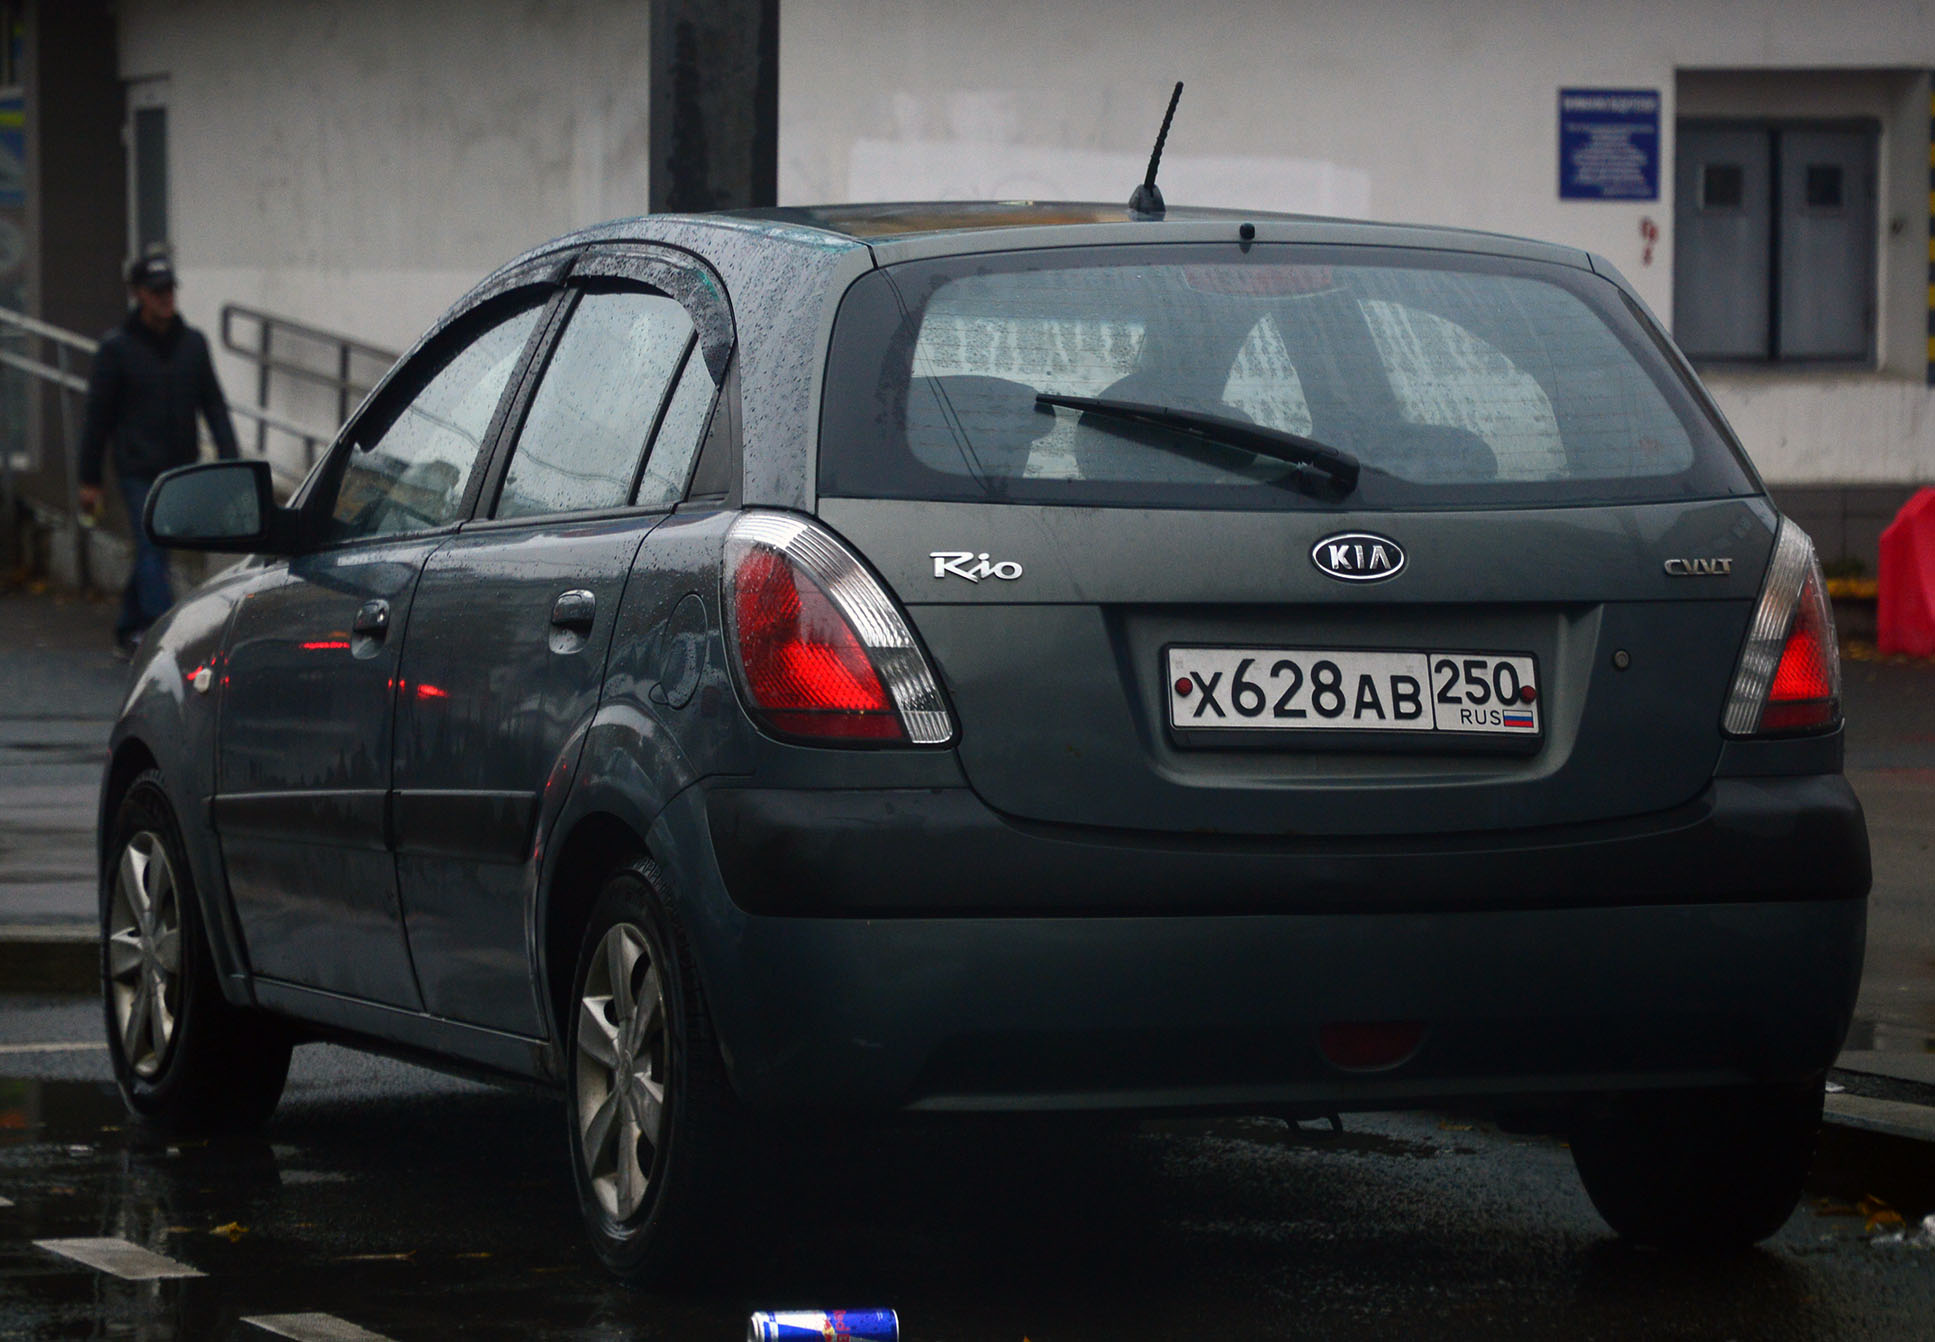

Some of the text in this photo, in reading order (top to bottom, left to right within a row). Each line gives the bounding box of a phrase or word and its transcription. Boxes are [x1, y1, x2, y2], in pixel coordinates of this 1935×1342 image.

[929, 551, 1024, 583] Rio
[1328, 544, 1392, 570] KIA
[1664, 558, 1733, 576] CVVT
[1434, 659, 1521, 706] 250
[1460, 707, 1501, 726] RUS
